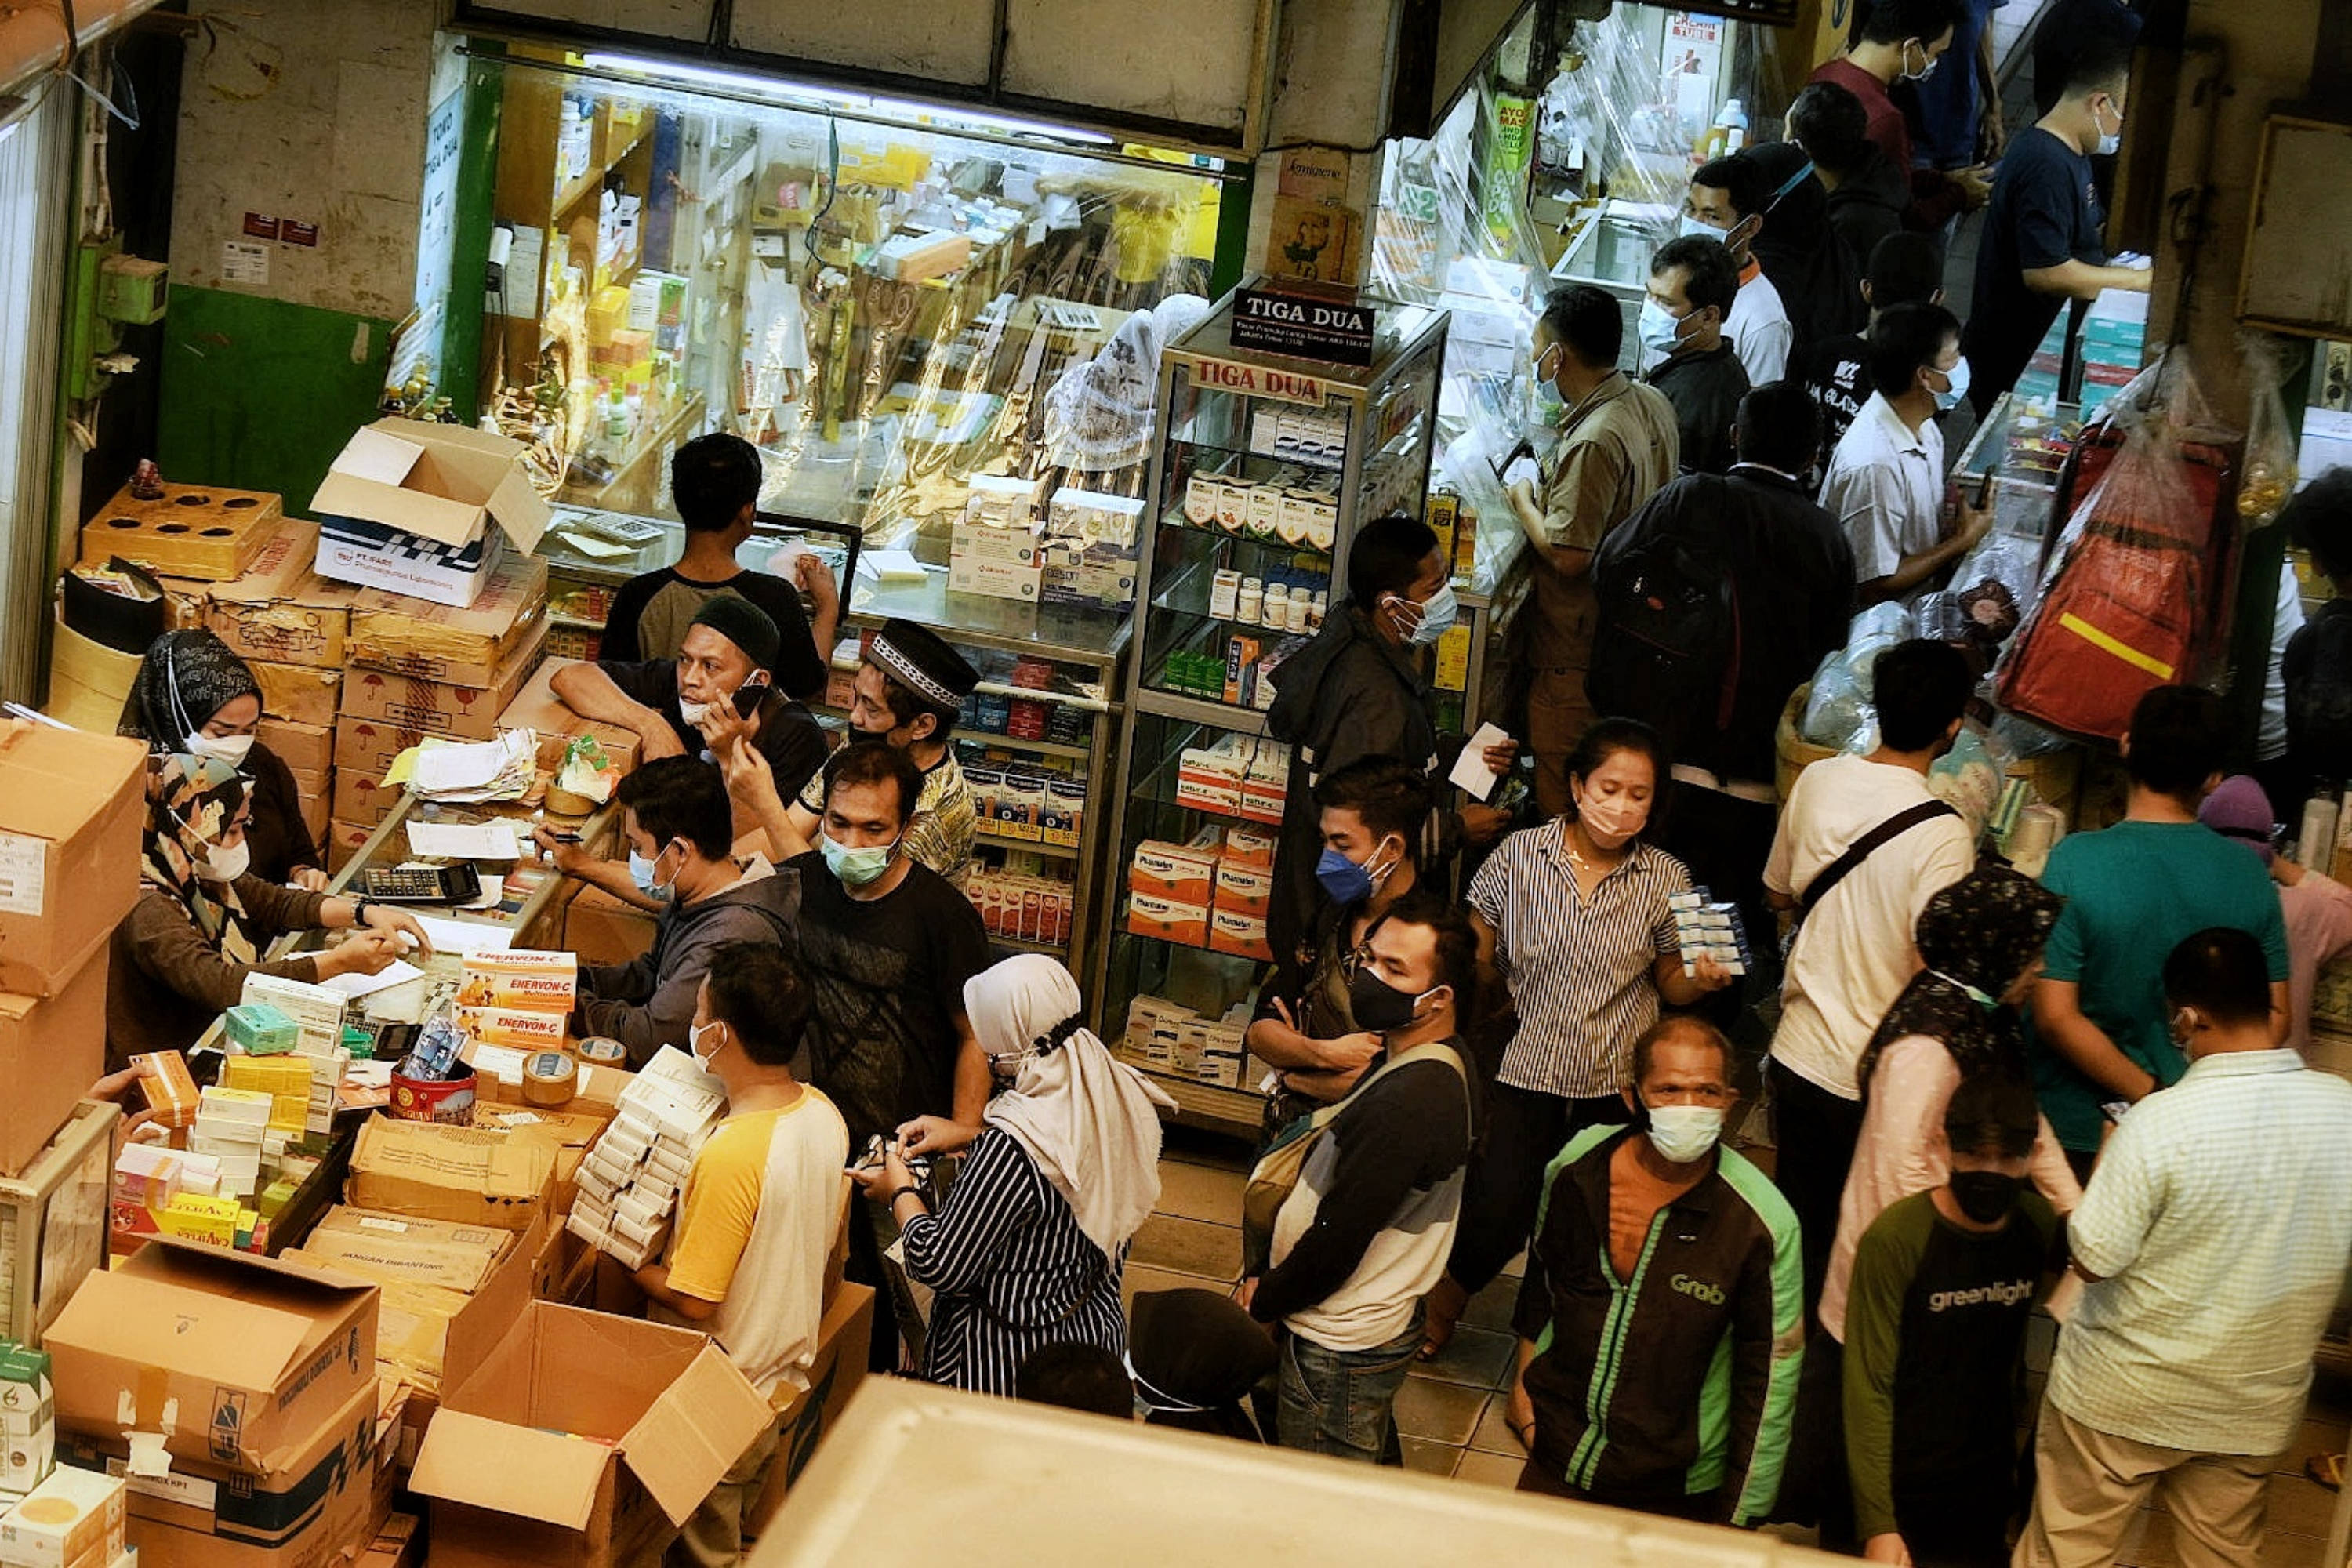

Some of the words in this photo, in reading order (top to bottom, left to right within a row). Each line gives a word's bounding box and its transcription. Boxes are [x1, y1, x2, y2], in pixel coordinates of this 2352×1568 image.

[1247, 297, 1305, 323] TIGA
[1313, 308, 1364, 331] DUA
[1198, 361, 1255, 390] TIGA
[1266, 372, 1318, 400] DUA
[1221, 872, 1256, 887] Pharmaton
[475, 952, 561, 963] ENERVON-C
[510, 978, 571, 991] ENERVON-C
[497, 1017, 557, 1033] ENERVON-C
[341, 1252, 384, 1265] JANGAN
[1670, 1273, 1726, 1305] Grab
[1929, 1279, 2034, 1313] greenlight
